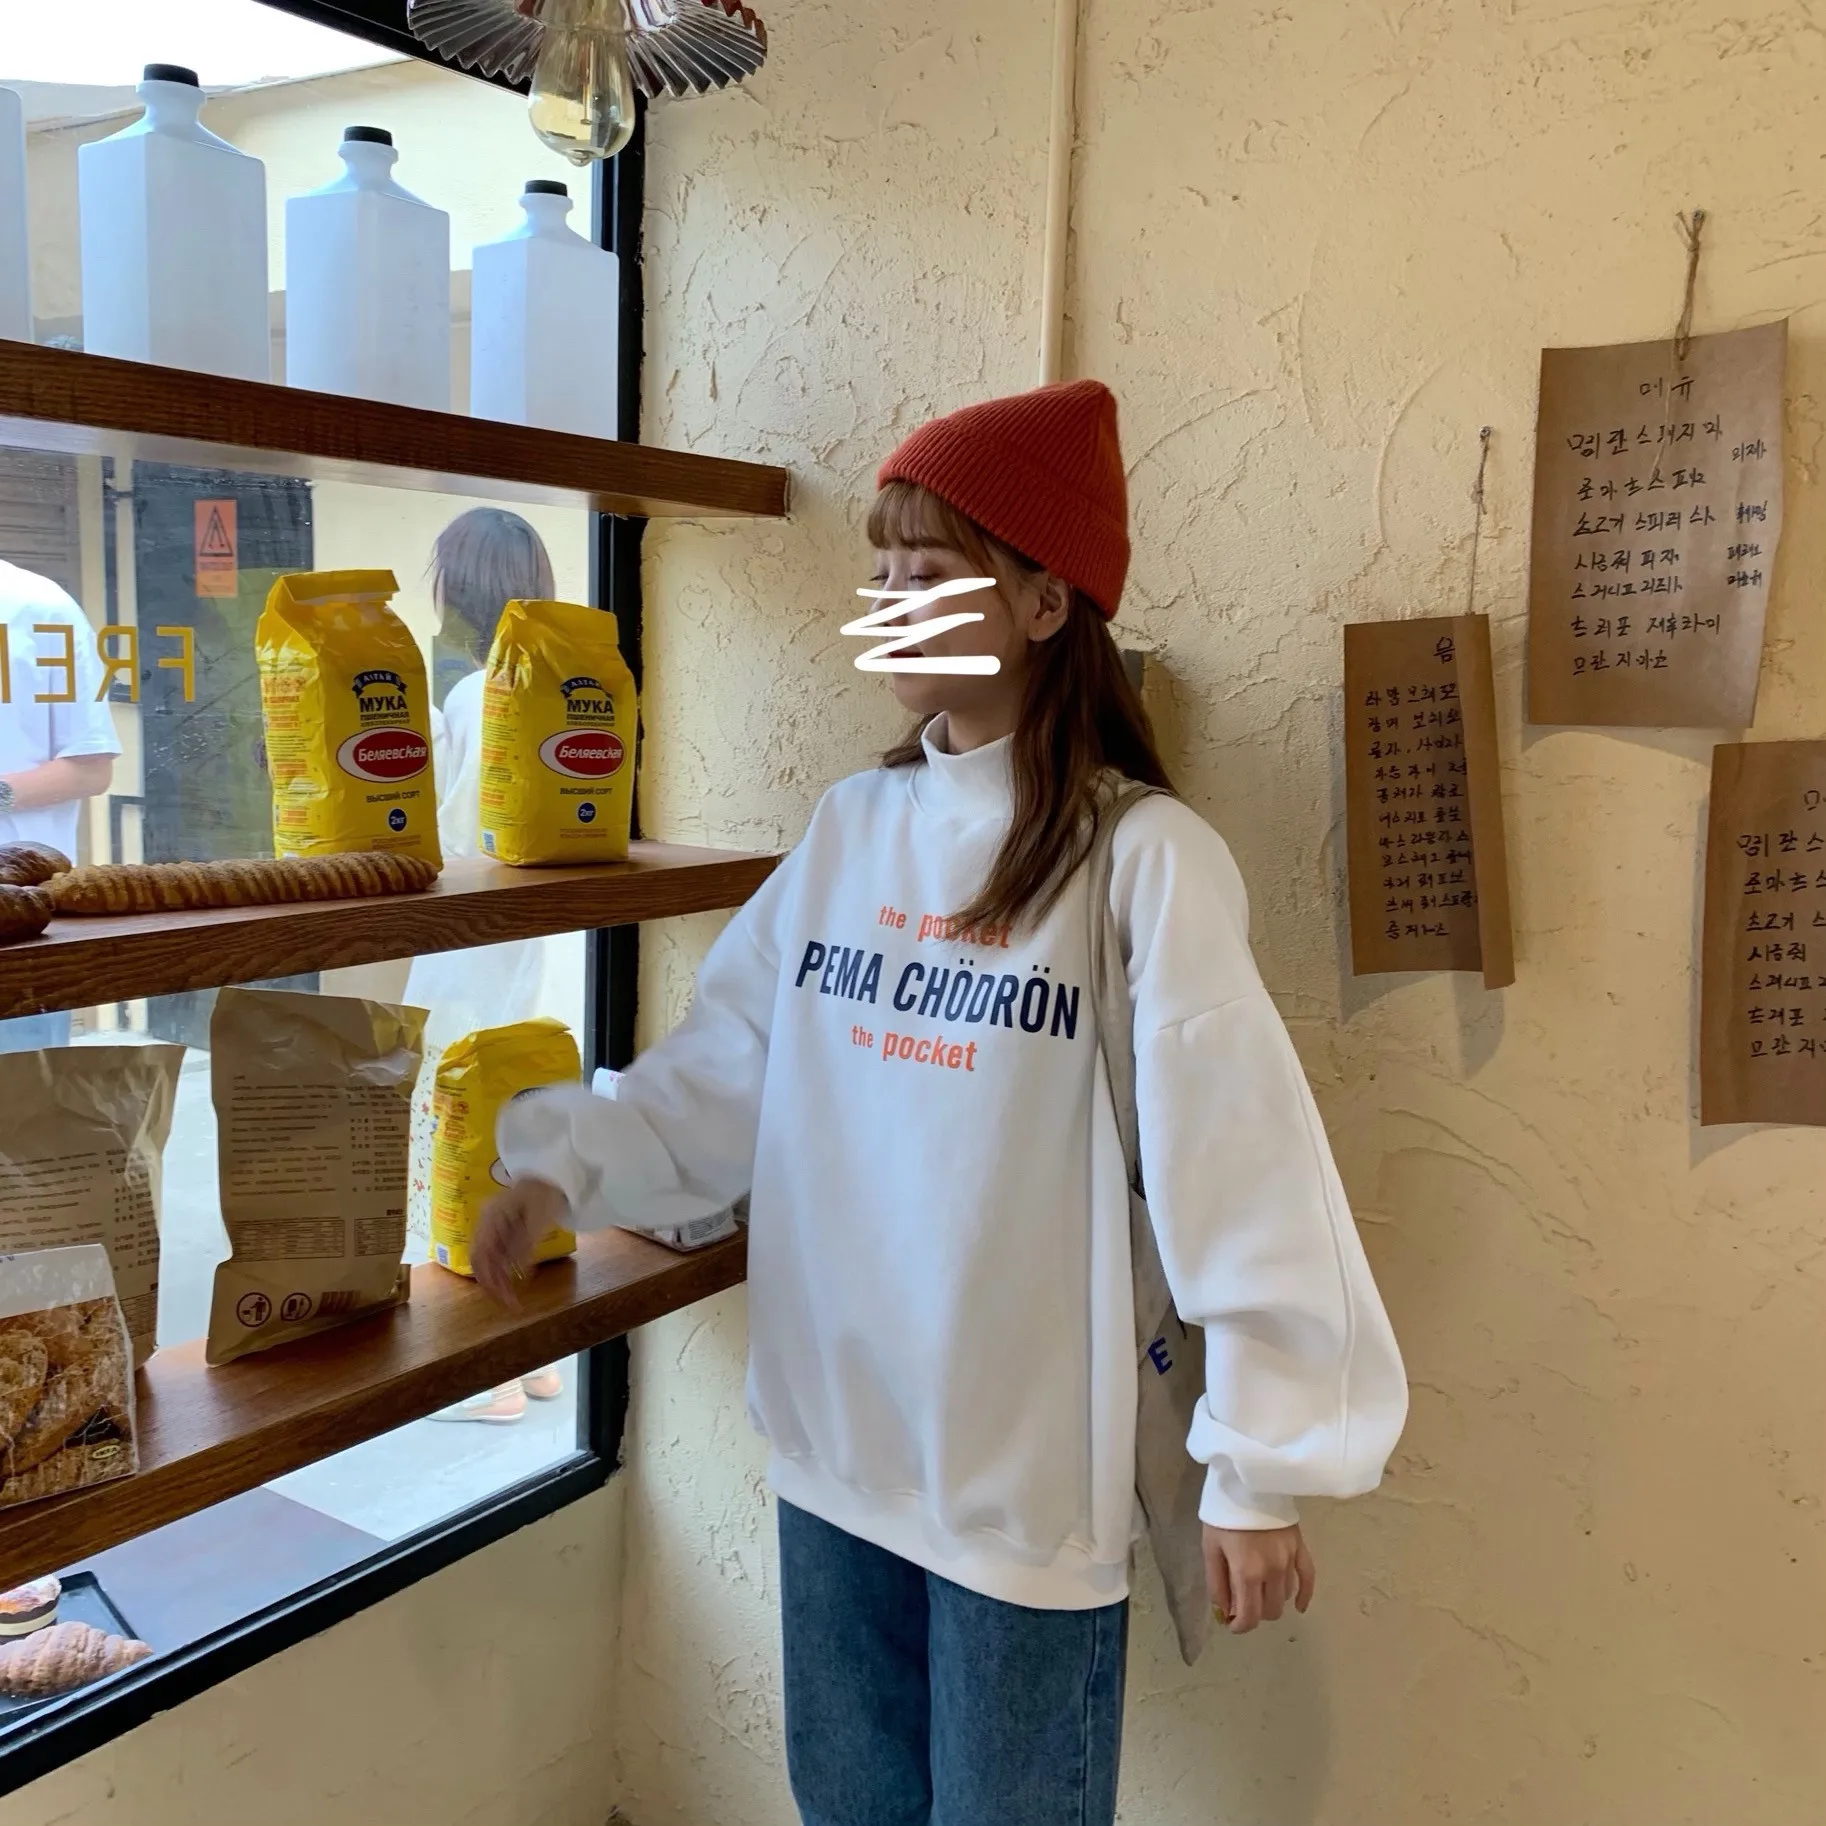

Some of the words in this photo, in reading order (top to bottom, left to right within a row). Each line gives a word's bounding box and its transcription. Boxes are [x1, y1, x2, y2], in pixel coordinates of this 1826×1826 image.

[360, 695, 408, 712] МУКА
[567, 699, 614, 714] МУКА
[358, 745, 427, 763] Беляевская
[877, 904, 907, 930] the
[795, 940, 884, 1005] PEMA
[892, 957, 1081, 1041] CHÖDRÖN
[851, 1024, 874, 1049] the
[882, 1031, 978, 1073] pocket
[1147, 1336, 1174, 1377] E
